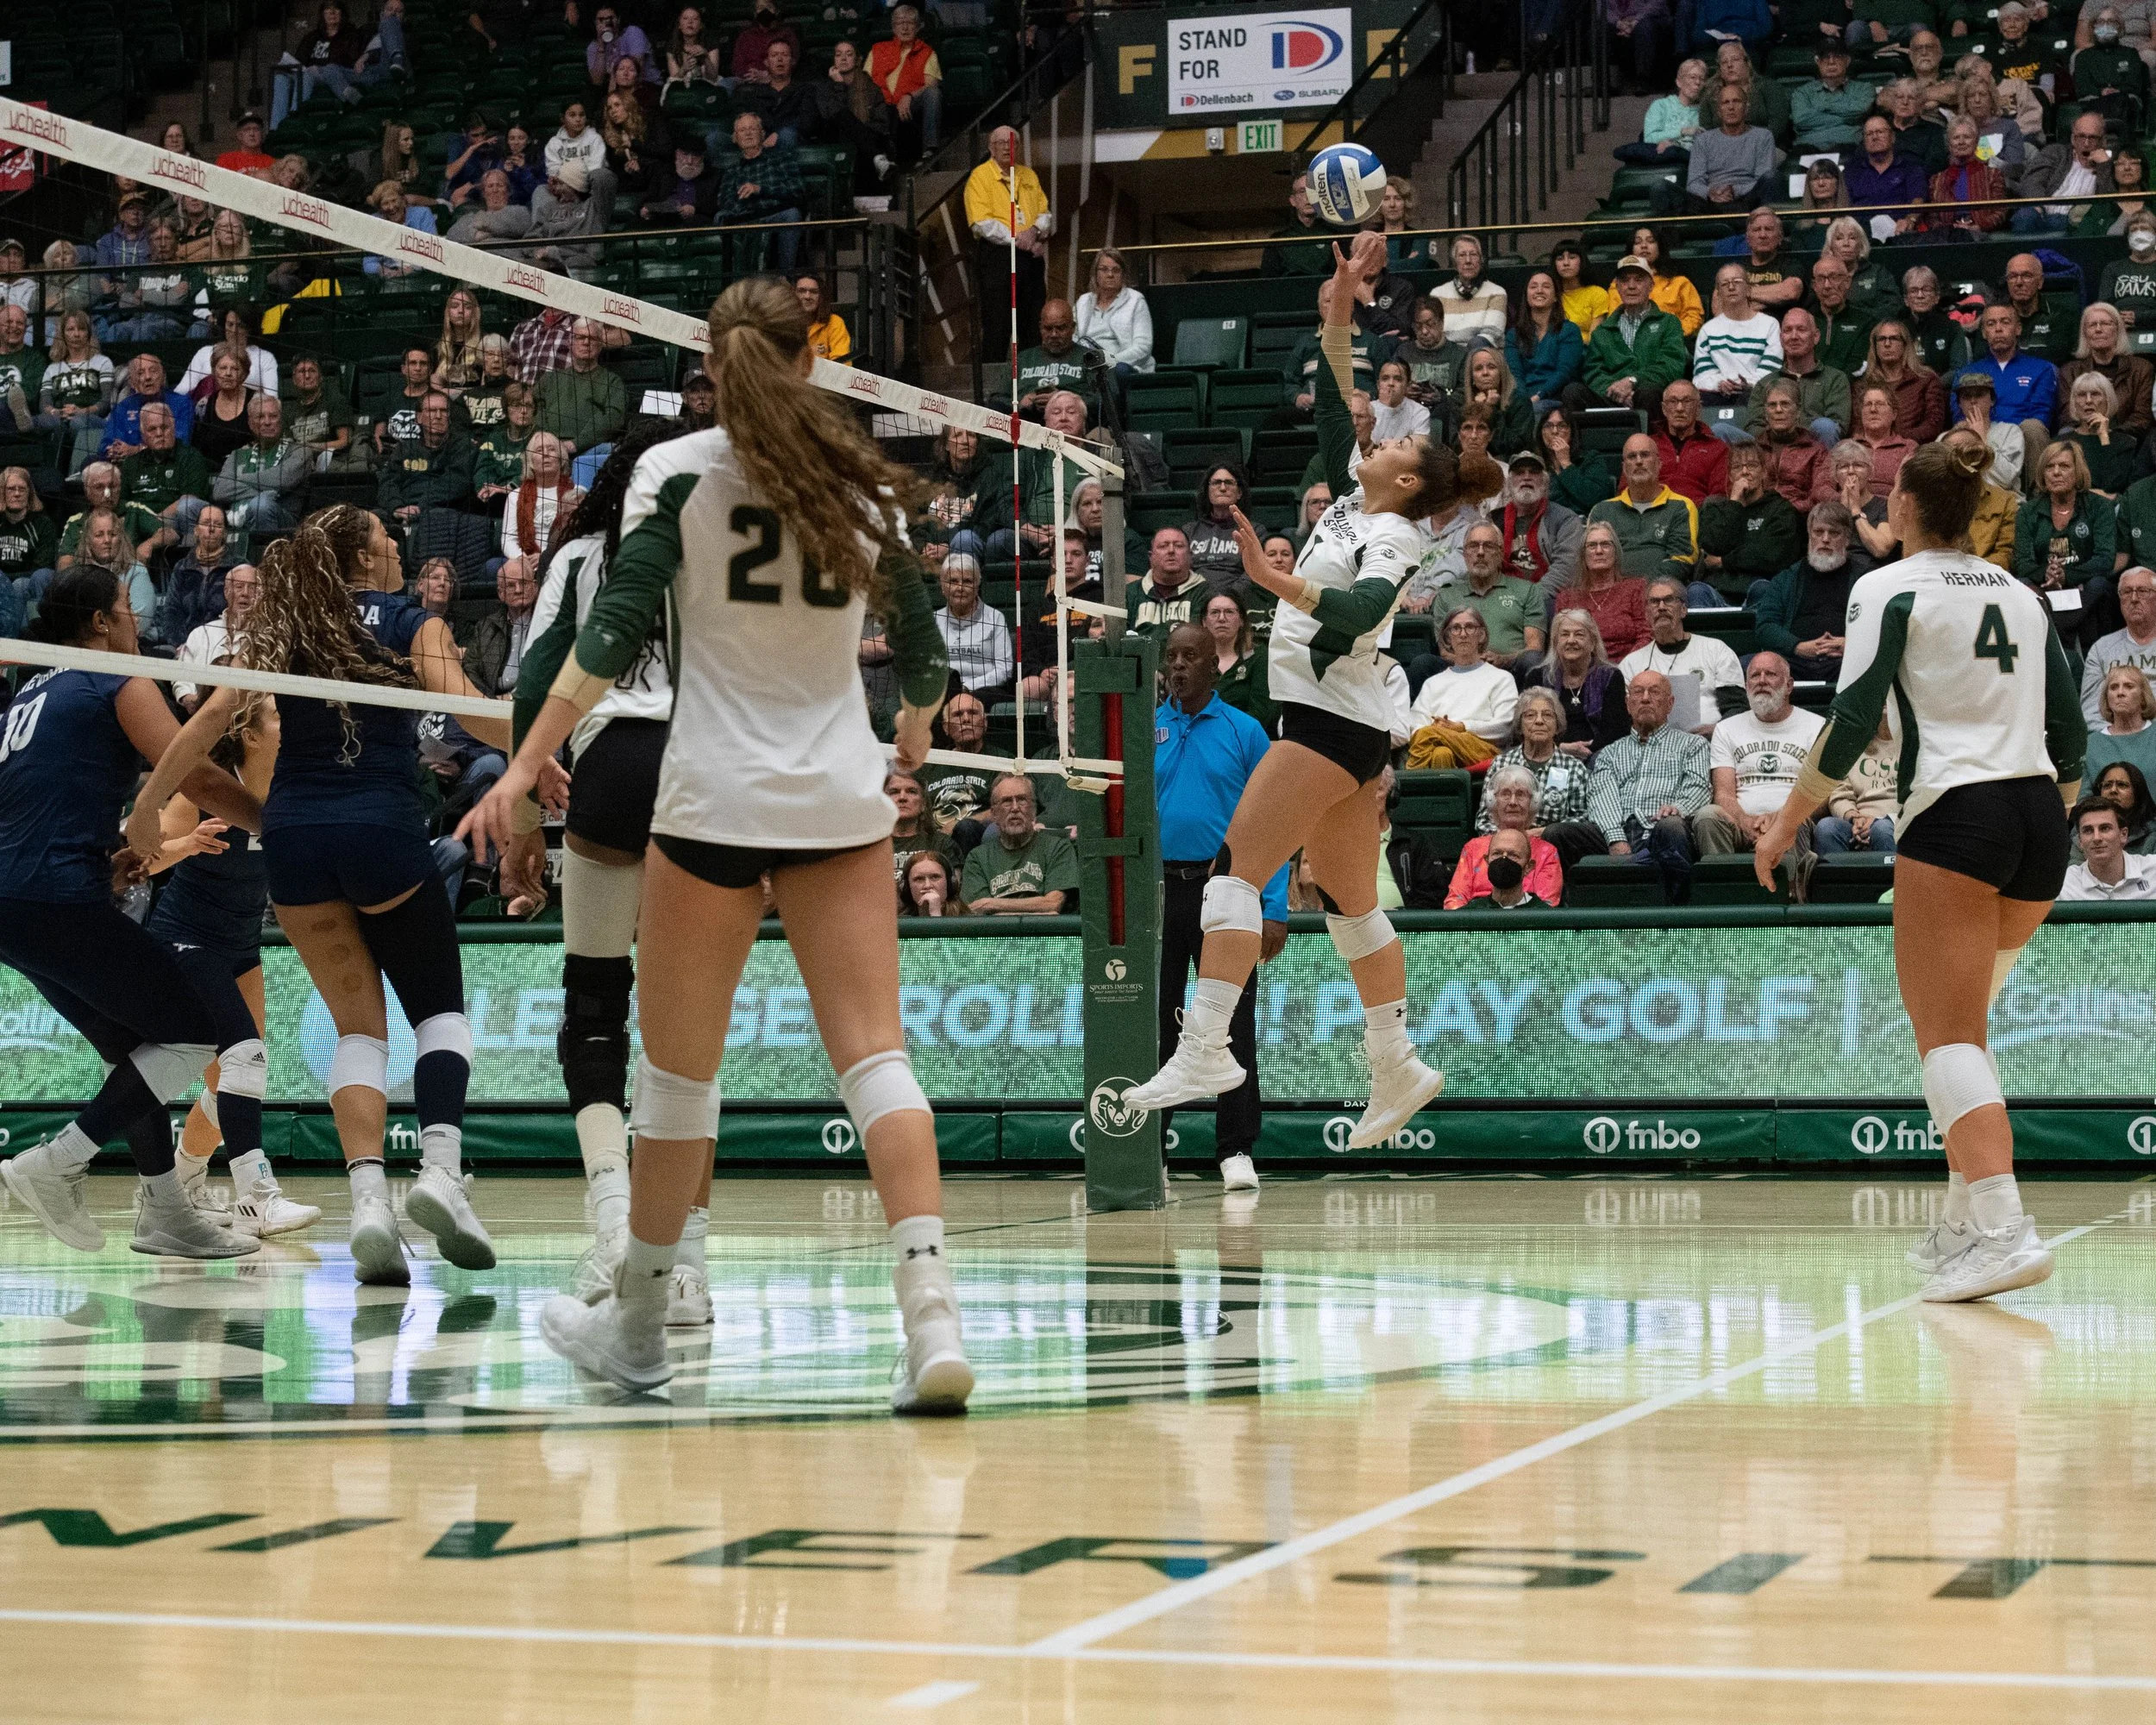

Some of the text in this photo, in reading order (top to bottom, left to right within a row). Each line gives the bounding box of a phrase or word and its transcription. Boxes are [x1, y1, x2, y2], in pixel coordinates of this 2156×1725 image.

[1179, 28, 1247, 51] STAND
[1180, 59, 1220, 80] FOR
[1200, 92, 1254, 106] Dellenbach
[1298, 88, 1344, 97] SUBARU
[8, 106, 68, 146] uchealth
[1245, 123, 1276, 151] EXIT
[152, 153, 207, 188] uchealth
[1317, 172, 1336, 216] molten
[282, 195, 329, 226] uchealth
[399, 232, 444, 261] uchealth
[506, 267, 545, 295] uchealth
[604, 292, 641, 323] uchealth
[849, 372, 881, 396] uchealth
[1020, 362, 1082, 380] COLORADO STATE
[920, 392, 949, 417] uchealth
[1189, 536, 1239, 555] CSU RAMS
[1940, 571, 2010, 587] HERMAN
[1973, 602, 2019, 674] 4
[0, 691, 47, 763] 10
[1733, 740, 1808, 764] COLORADO STATE
[1859, 756, 1900, 778] CS
[927, 775, 987, 792] COLORADO STATE
[1089, 984, 1113, 993] SPORTS
[1312, 980, 1540, 1044] PAY
[1561, 976, 1816, 1042] GOLF
[1626, 1120, 1701, 1150] fnbo
[1894, 1120, 1946, 1151] fnb
